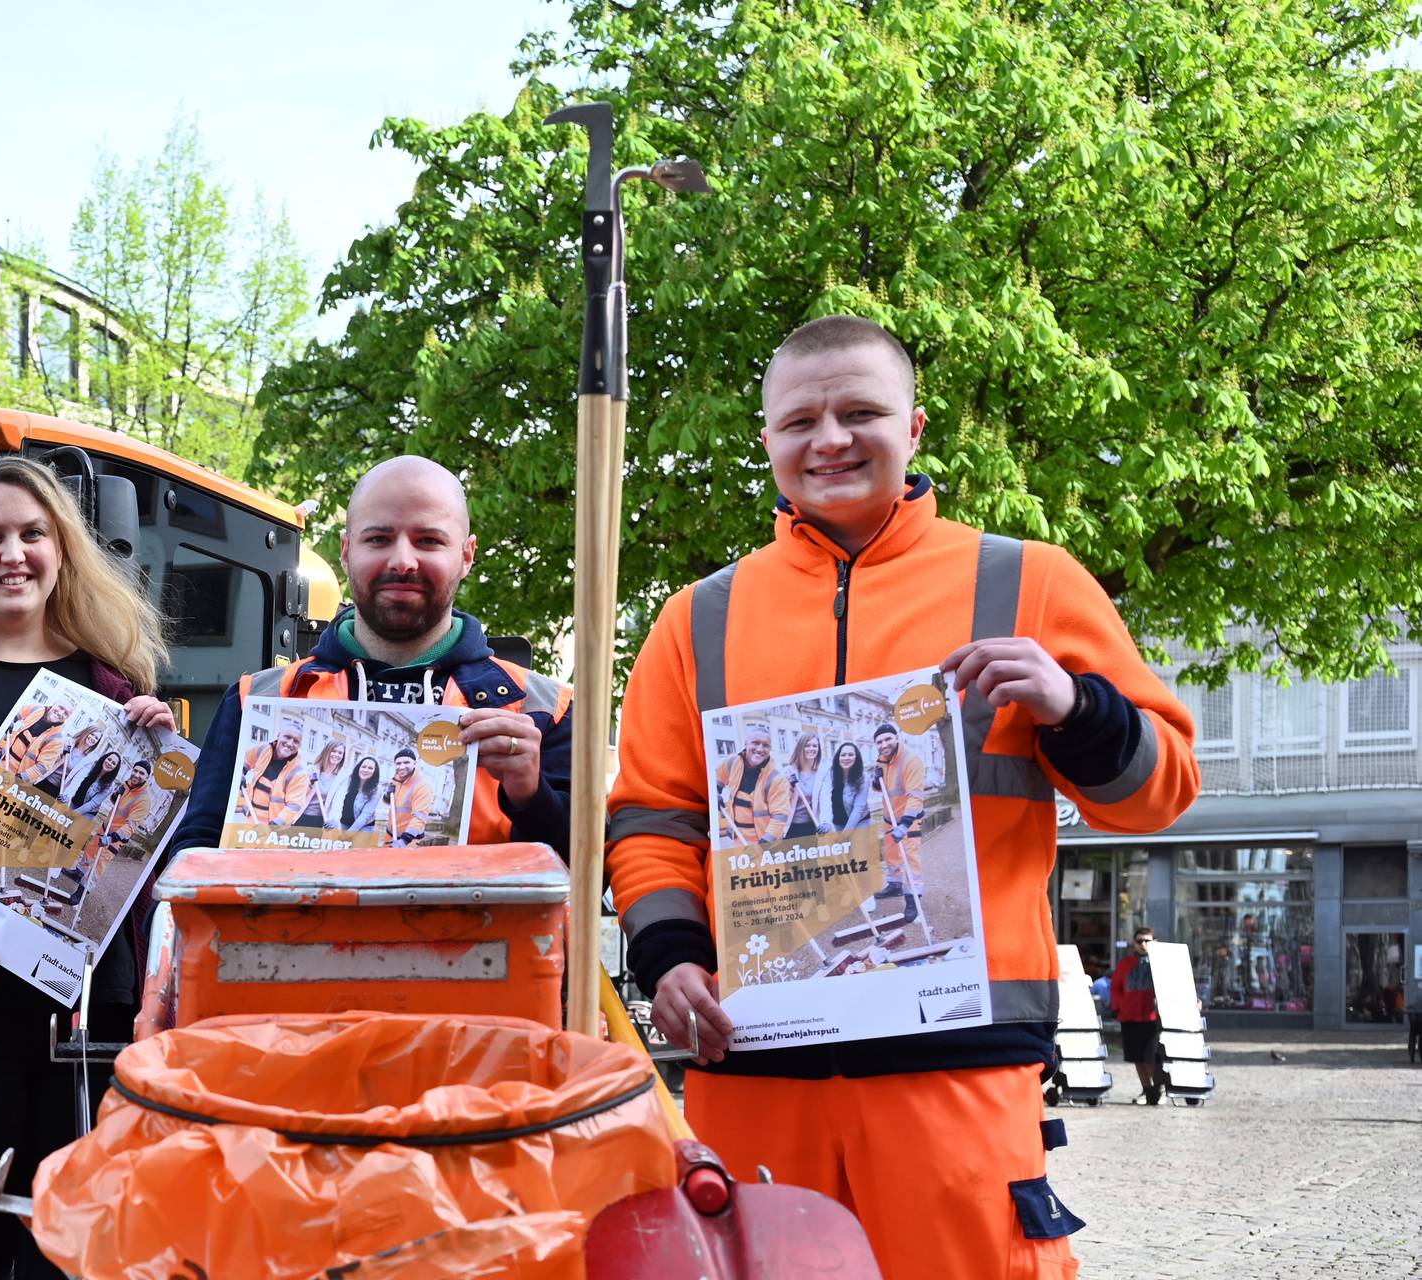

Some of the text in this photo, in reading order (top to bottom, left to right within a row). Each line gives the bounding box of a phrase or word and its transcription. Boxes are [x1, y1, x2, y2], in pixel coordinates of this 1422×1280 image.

[6, 784, 74, 828] Aachener
[2, 820, 29, 840] anpacken
[237, 830, 352, 850] 10. Aachener
[728, 842, 851, 870] 10. Aachener
[730, 859, 868, 890] Frühjahrsputz
[732, 890, 816, 908] Gemeinsam anpacken
[746, 908, 772, 916] unsere
[774, 902, 798, 912] Stadt!
[765, 915, 783, 925] April
[786, 912, 804, 920] 2024
[42, 953, 82, 982] stadt aachen
[918, 982, 980, 998] stadt aachen
